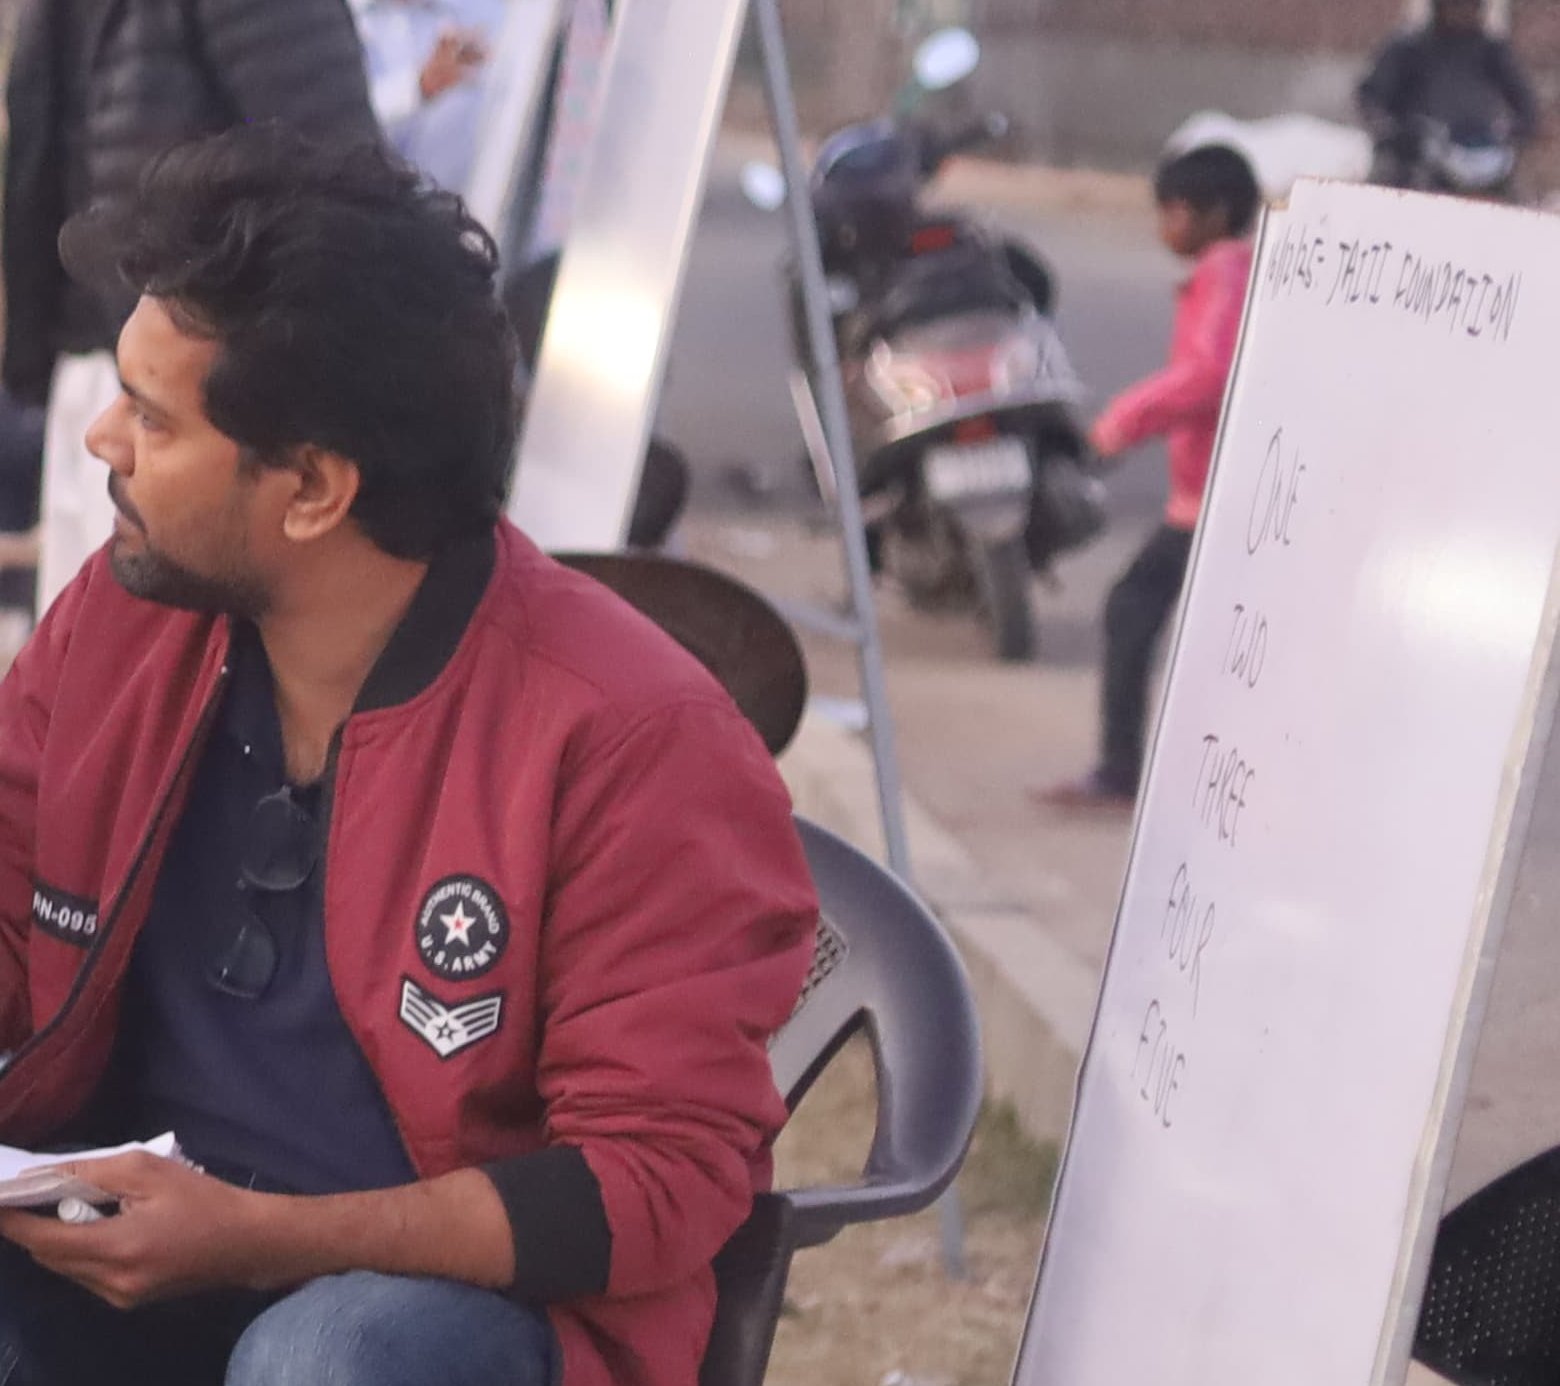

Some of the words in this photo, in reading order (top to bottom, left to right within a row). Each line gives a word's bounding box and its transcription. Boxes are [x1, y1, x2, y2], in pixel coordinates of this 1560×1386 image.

[1393, 249, 1522, 342] FOUNDATION
[1246, 426, 1307, 556] ONE
[1221, 603, 1268, 689] TWO
[1192, 733, 1256, 849] THREE
[1160, 861, 1217, 1021] FOUR
[1131, 997, 1187, 1130] FIVE
